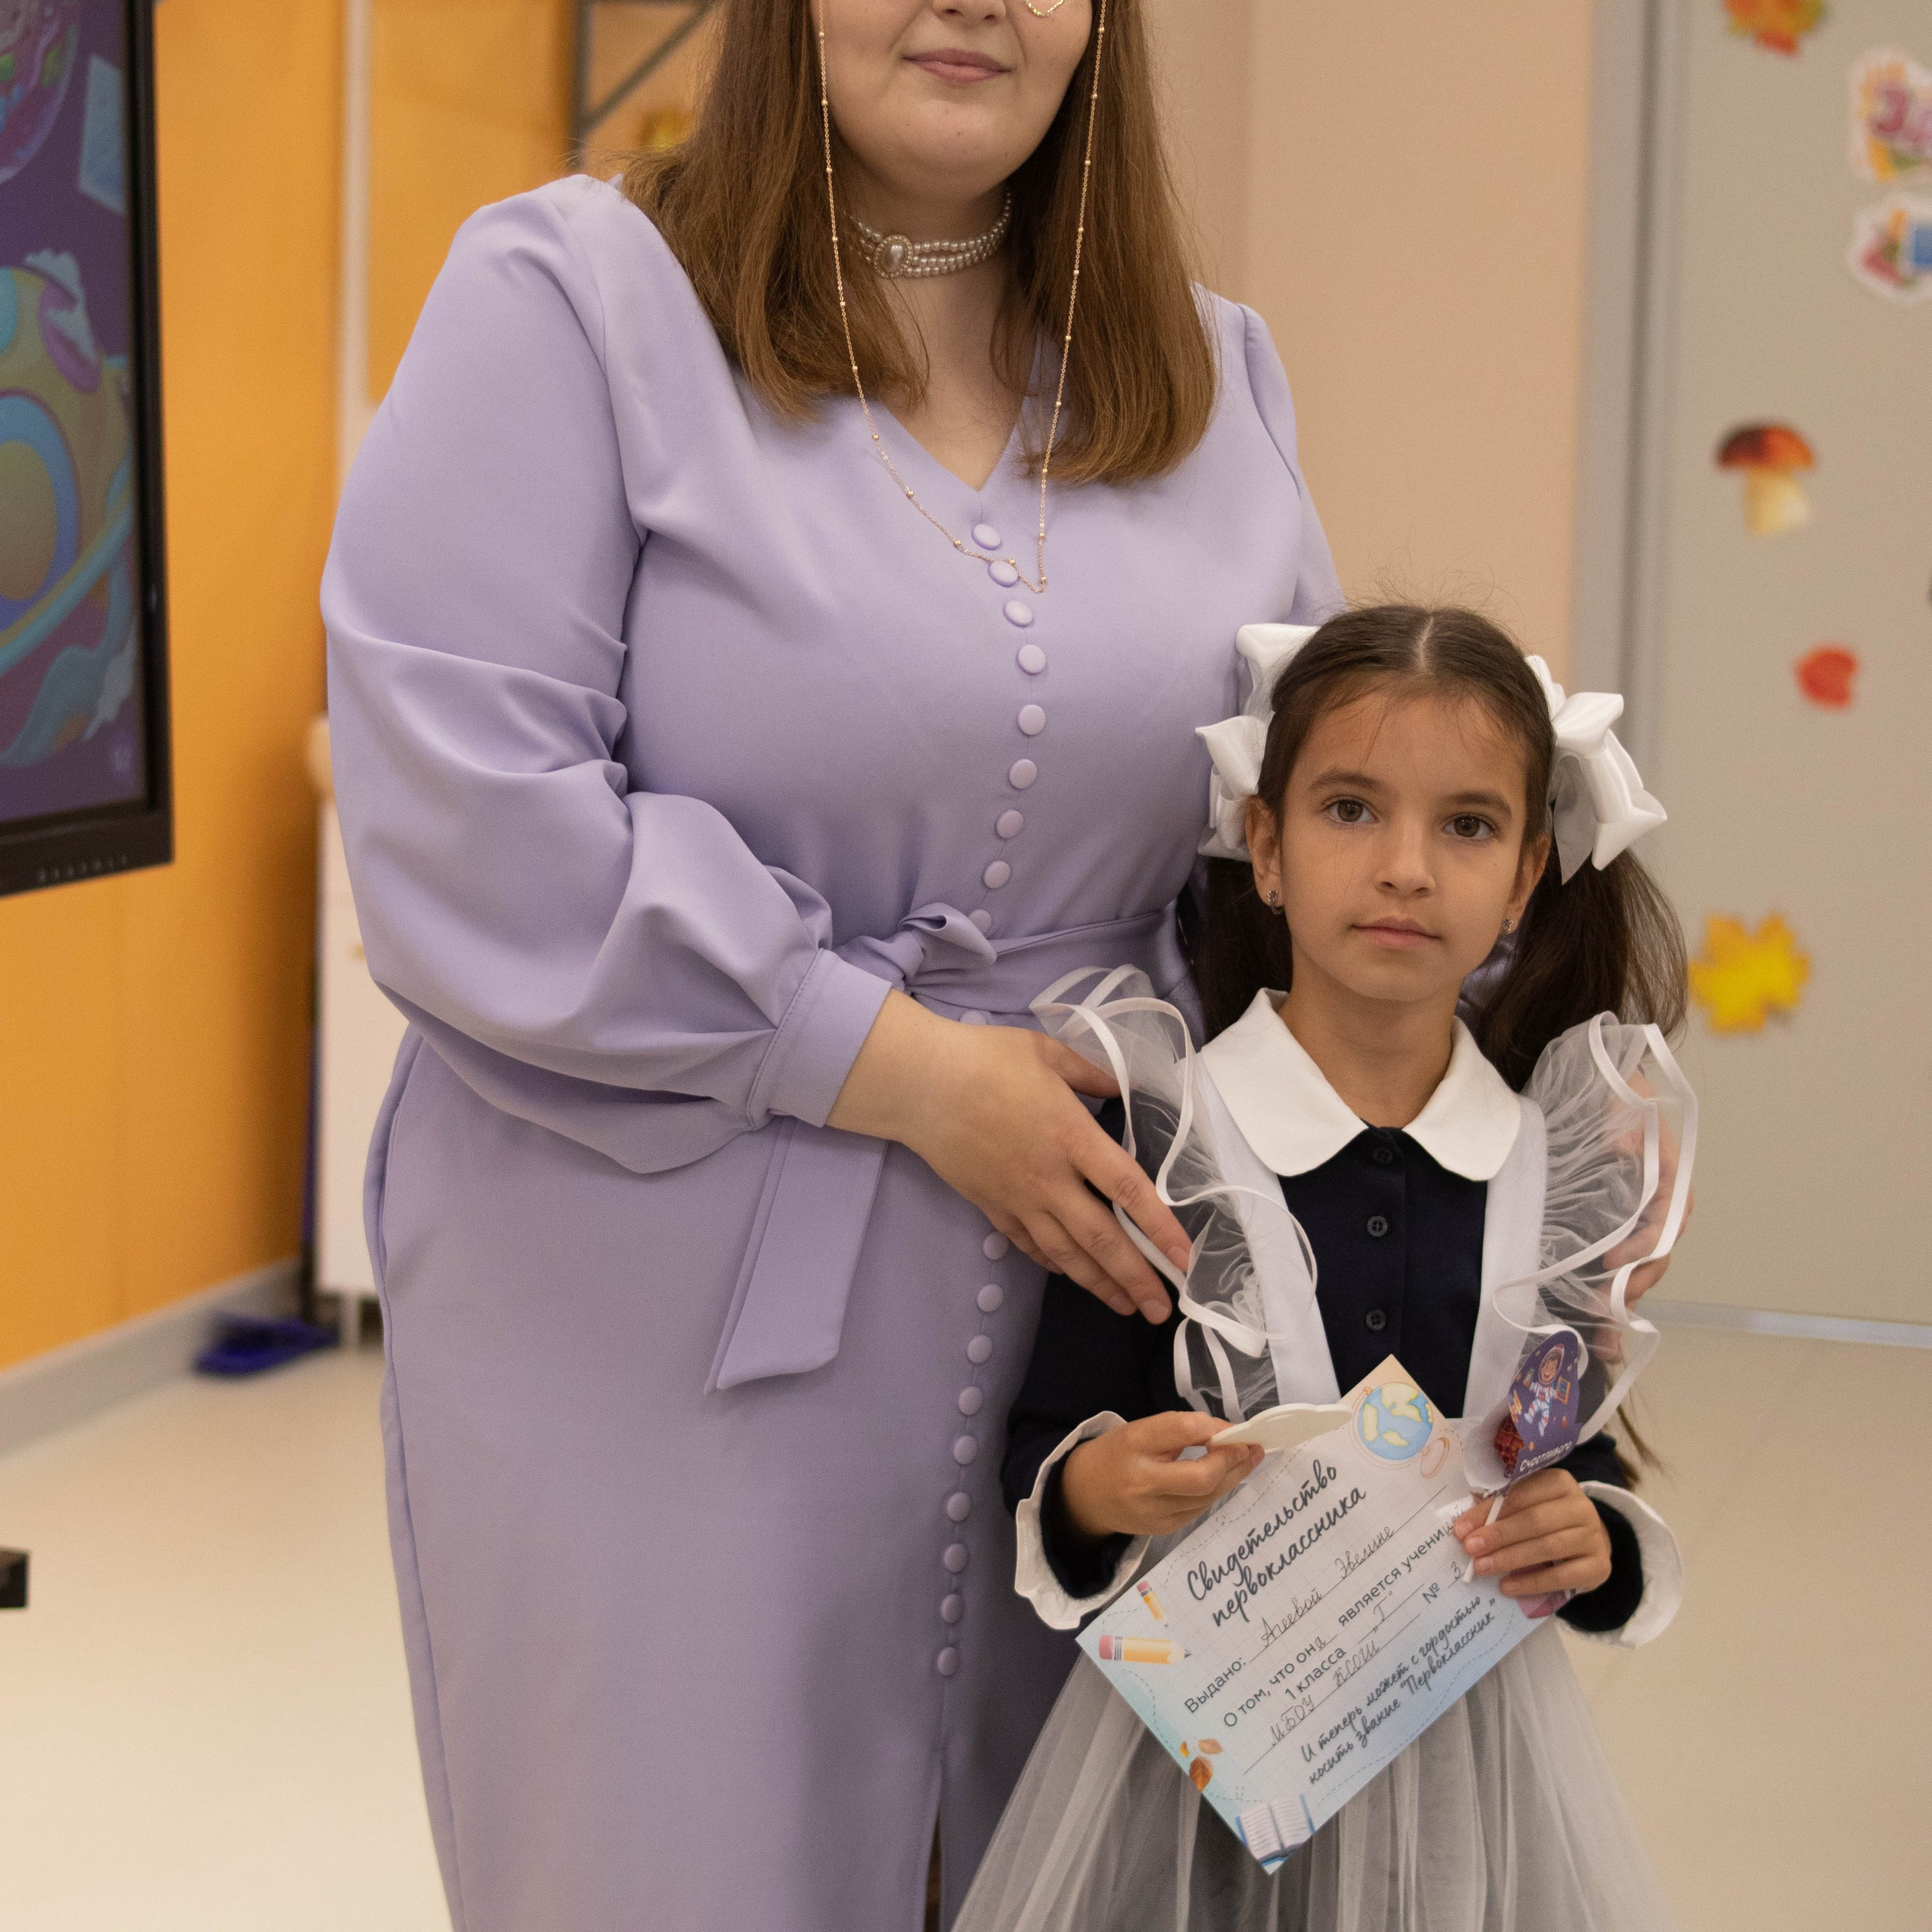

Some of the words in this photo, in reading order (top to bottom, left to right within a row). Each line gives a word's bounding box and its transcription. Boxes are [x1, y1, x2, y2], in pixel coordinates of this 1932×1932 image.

[1187, 1460, 1337, 1601] Свидетельство
[1212, 1487, 1366, 1626] первоклассника
[1184, 1657, 1246, 1713] Выдано:
[1335, 1527, 1395, 1579] Эвелине
[1223, 1712, 1238, 1727] О
[1238, 1688, 1271, 1714] том,
[1269, 1663, 1295, 1685] что
[1296, 1636, 1326, 1663] она
[1338, 1567, 1401, 1626] является
[1270, 1694, 1315, 1746] МБОУ
[1423, 1582, 1440, 1604] №
[1284, 1688, 1297, 1700] 1
[1297, 1647, 1346, 1693] класса
[1301, 1743, 1317, 1762] И
[1318, 1706, 1362, 1750] теперь
[1366, 1663, 1409, 1706] может
[1411, 1654, 1420, 1665] с
[1419, 1596, 1481, 1657] гордостью
[1309, 1743, 1354, 1785] носить
[1355, 1699, 1401, 1749] звание
